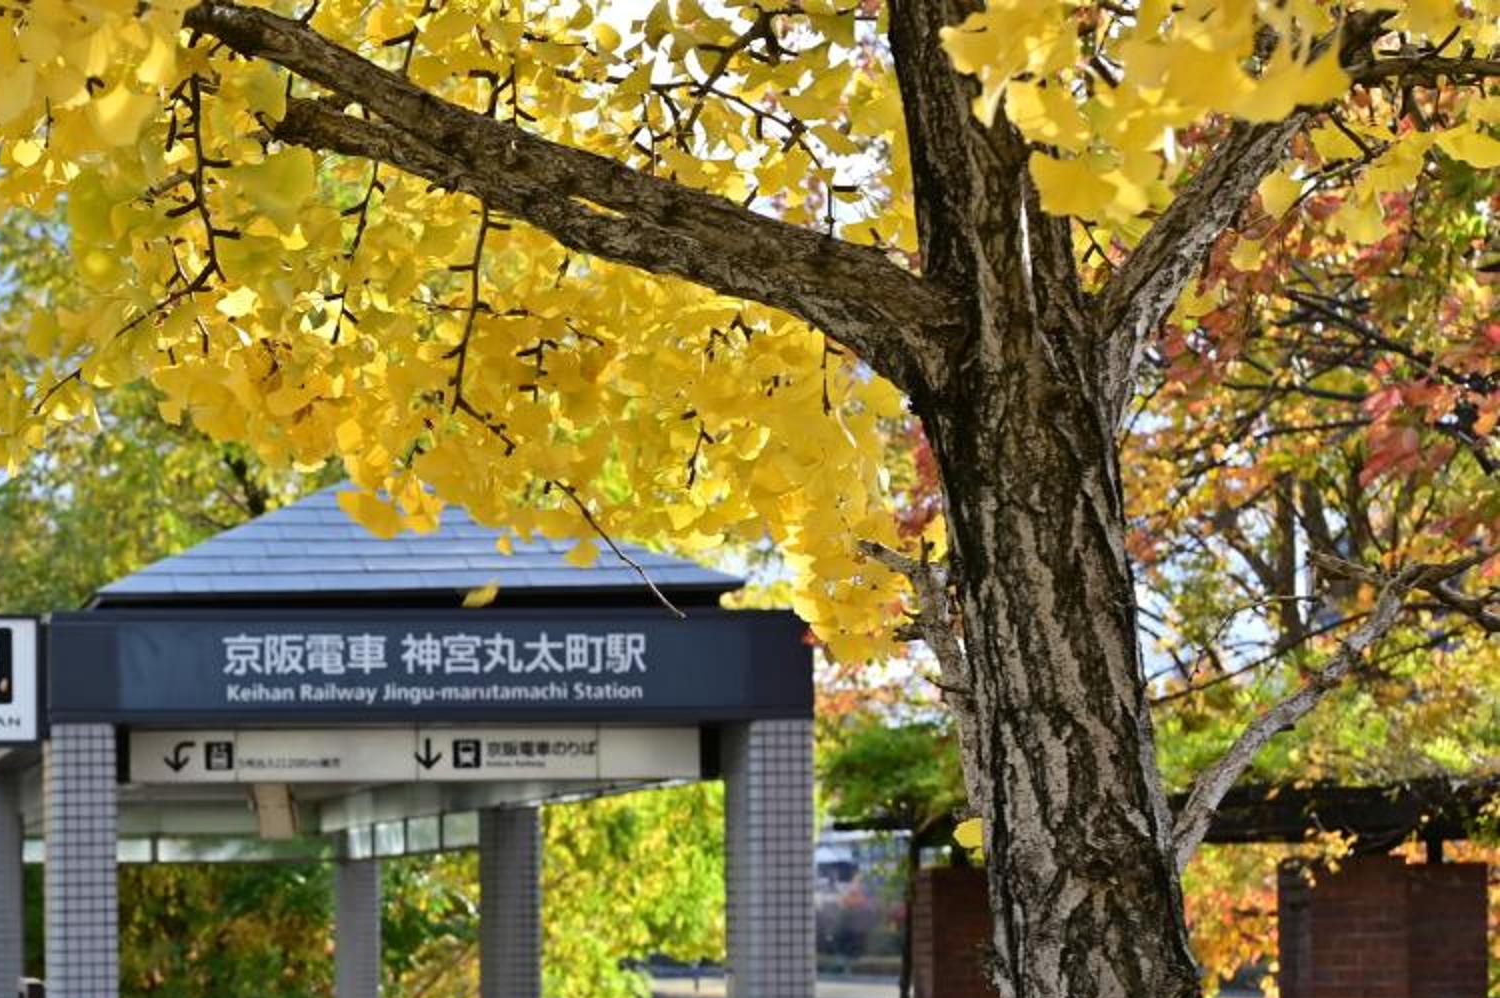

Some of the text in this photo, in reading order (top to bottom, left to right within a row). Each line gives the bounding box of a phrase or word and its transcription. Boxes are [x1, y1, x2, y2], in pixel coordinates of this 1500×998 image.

[222, 632, 646, 675] 京阪電車 神宮丸太町駅
[227, 682, 643, 704] Keihan Railway Jingu-marutamachi Station
[486, 741, 596, 757] 京阪電車のりば
